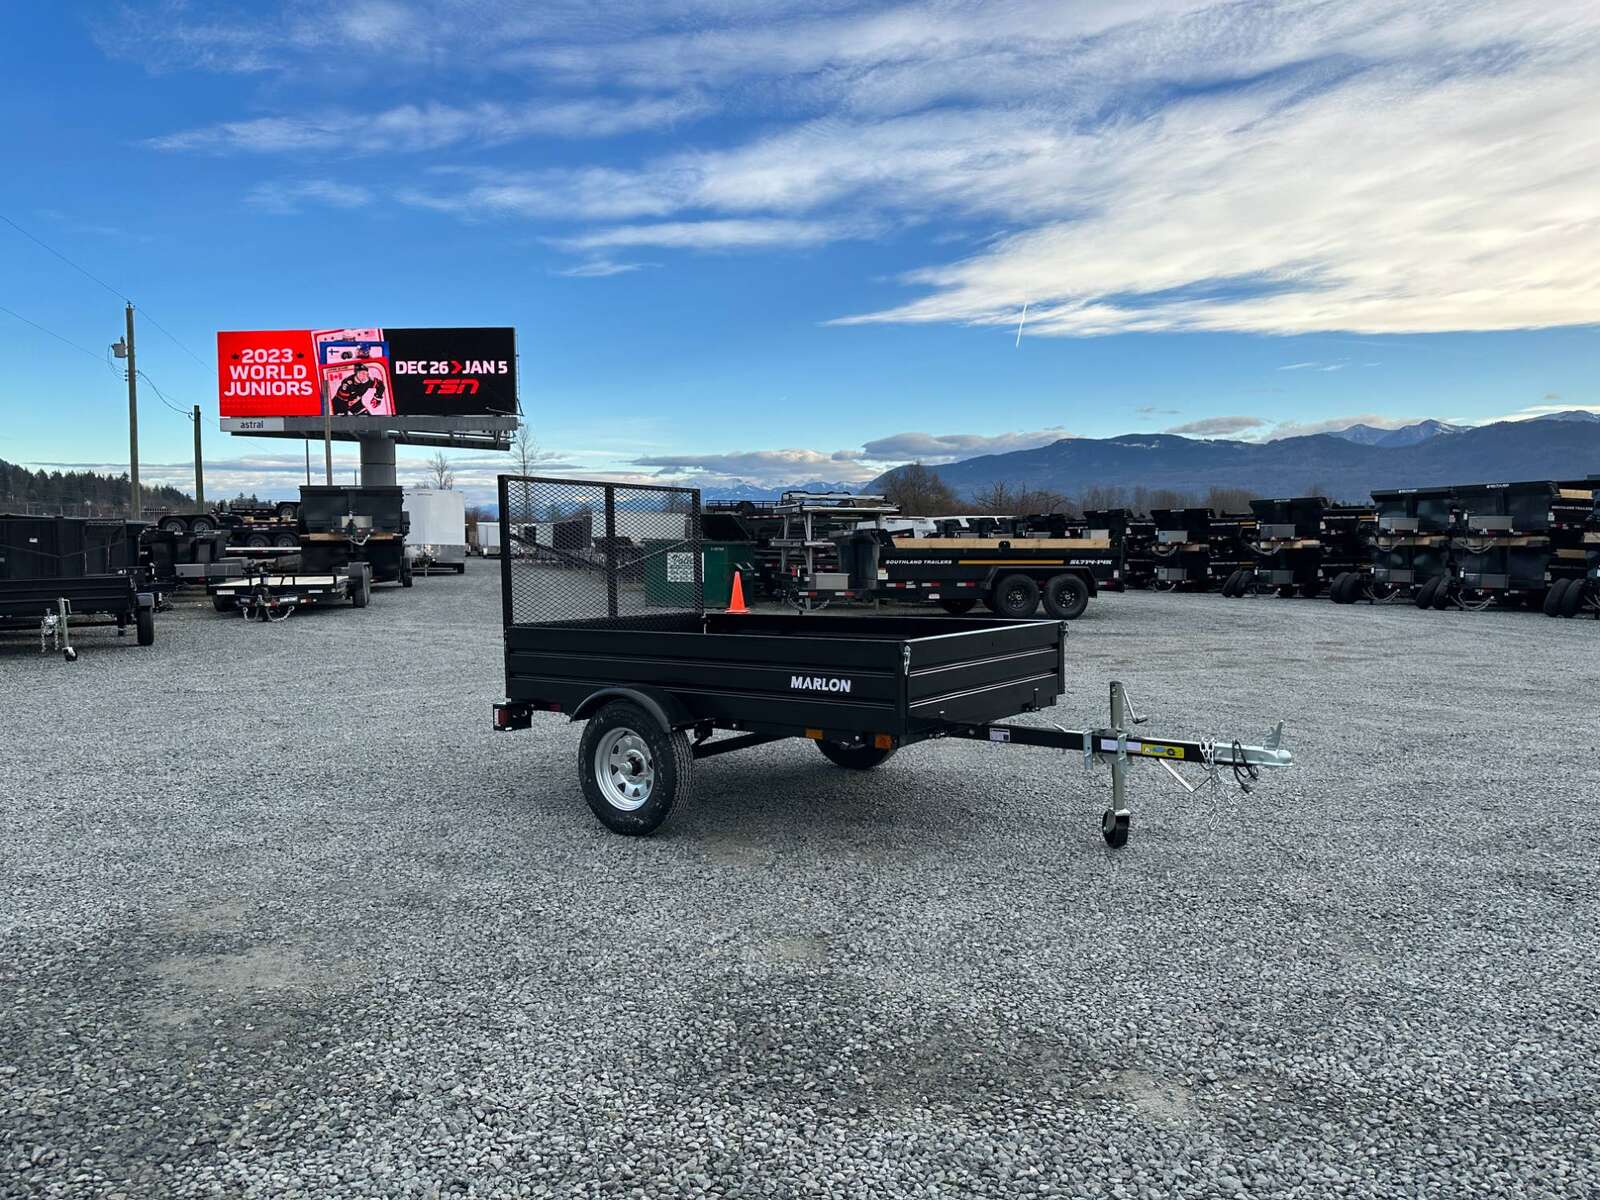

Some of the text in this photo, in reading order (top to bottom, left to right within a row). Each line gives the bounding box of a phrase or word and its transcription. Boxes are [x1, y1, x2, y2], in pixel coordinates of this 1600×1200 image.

[241, 348, 293, 364] 2023
[229, 364, 307, 380] WORLD
[395, 360, 508, 375] DEC 26 JAN 5
[223, 381, 313, 396] JUNIORS
[422, 379, 480, 394] TSN
[240, 420, 264, 429] astral
[791, 675, 852, 693] MARLON
